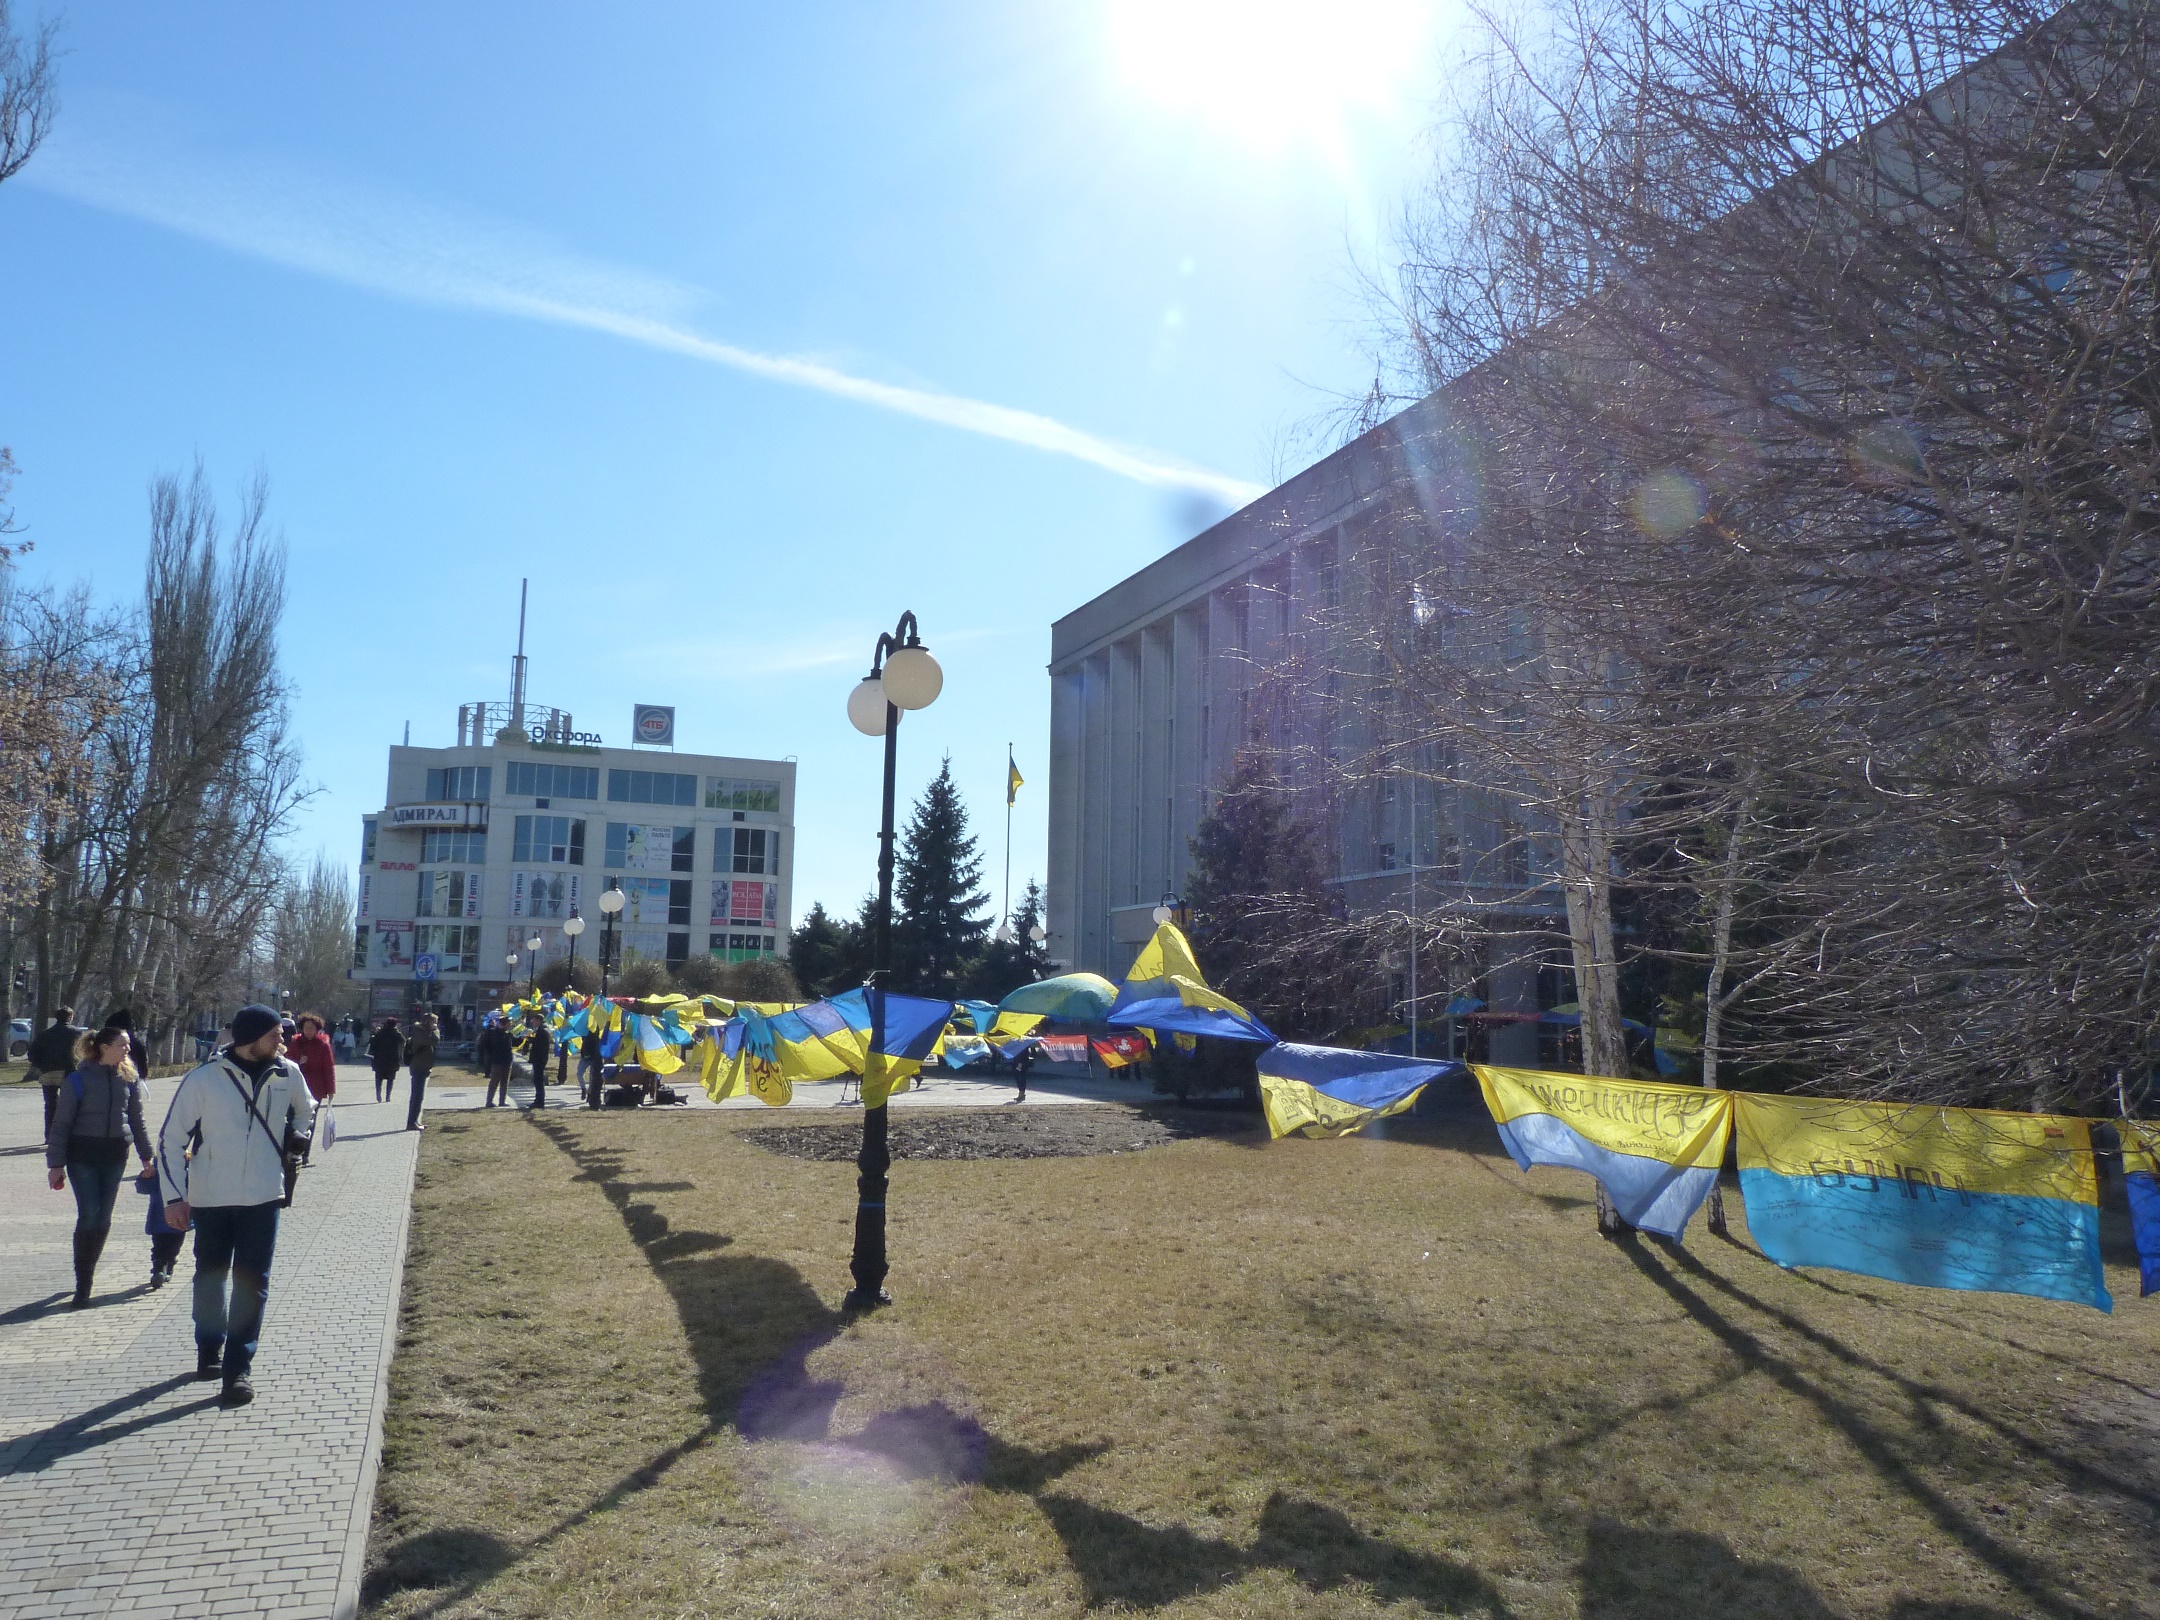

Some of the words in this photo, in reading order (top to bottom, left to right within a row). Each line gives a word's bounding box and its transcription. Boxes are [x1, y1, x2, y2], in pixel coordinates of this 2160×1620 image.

[642, 720, 664, 731] АТБ
[532, 726, 602, 744] Оксфорд
[392, 808, 457, 823] АДМИРАЛ
